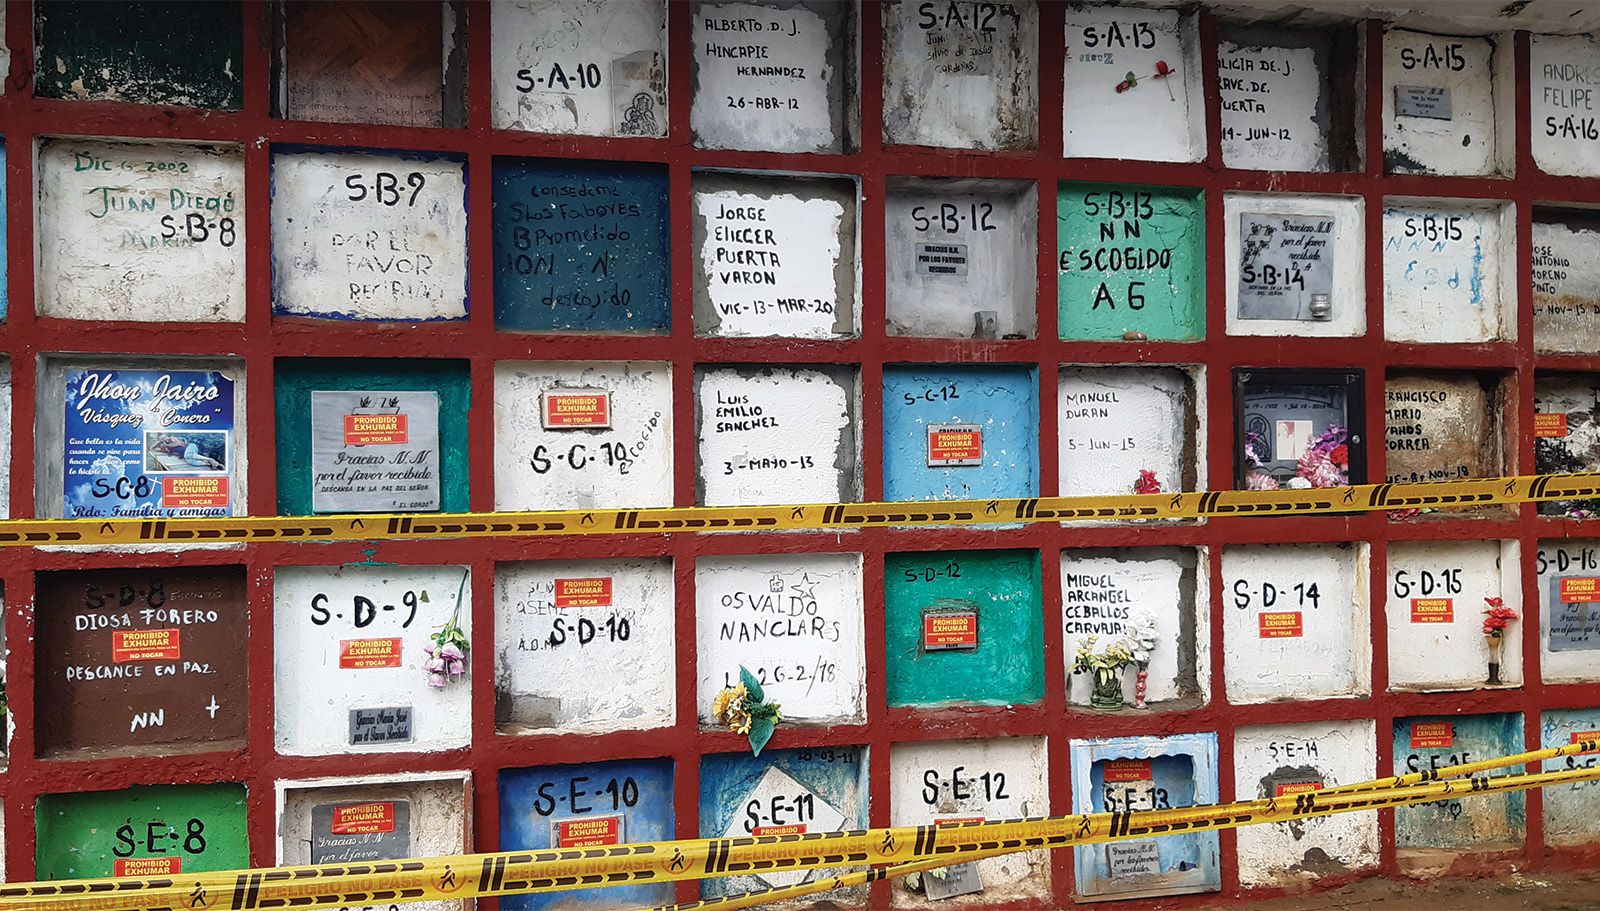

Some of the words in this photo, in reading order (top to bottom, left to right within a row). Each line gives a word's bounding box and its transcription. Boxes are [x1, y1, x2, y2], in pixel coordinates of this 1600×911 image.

[705, 18, 762, 32] ALBERTO
[706, 43, 768, 58] HINCAPIE
[737, 66, 806, 79] HERNANDEZ
[1544, 86, 1592, 110] FELIPE
[715, 203, 766, 221] JORGE
[1100, 222, 1114, 243] N
[1124, 219, 1140, 239] N
[716, 247, 781, 267] PUERTA
[720, 271, 776, 285] VARON
[1092, 282, 1115, 310] A
[77, 373, 141, 410] Jhon
[150, 375, 219, 410] Jairo
[717, 390, 749, 404] LUIS
[1066, 391, 1119, 405] MANUEL
[80, 408, 144, 429] Vásquez
[716, 407, 762, 418] EMILIO
[1066, 407, 1109, 419] DURAN
[354, 416, 397, 424] PROHIBIDO
[716, 419, 779, 433] SANCHEZ
[354, 423, 397, 431] EXHUMAR
[334, 452, 385, 465] Gracias
[315, 471, 335, 486] por
[336, 468, 346, 480] el
[347, 469, 383, 485] favor
[111, 504, 163, 517] Familia
[563, 580, 603, 588] PROHIBIDO
[1067, 573, 1115, 588] MIGUEL
[1068, 589, 1132, 603] ARCANGEL
[721, 592, 817, 616] OSVALDO
[139, 609, 218, 625] FORERO
[1066, 606, 1130, 619] CEBALLOS
[75, 613, 131, 631] DIOSA
[123, 631, 169, 640] PROHIBIDO
[123, 638, 169, 647] EXHUMAR
[350, 640, 392, 648] PROHIBIDO
[350, 647, 392, 655] EXHUMAR
[155, 665, 176, 676] EN
[341, 805, 384, 815] PROHIBIDO
[341, 812, 384, 822] EXHUMAR
[569, 820, 609, 830] PROHIBIDO
[760, 827, 798, 835] PROHIBIDO
[569, 827, 609, 837] EXHUMAR
[318, 836, 357, 847] Gracias
[125, 867, 171, 875] EXHUMAR
[379, 874, 423, 891] PASE
